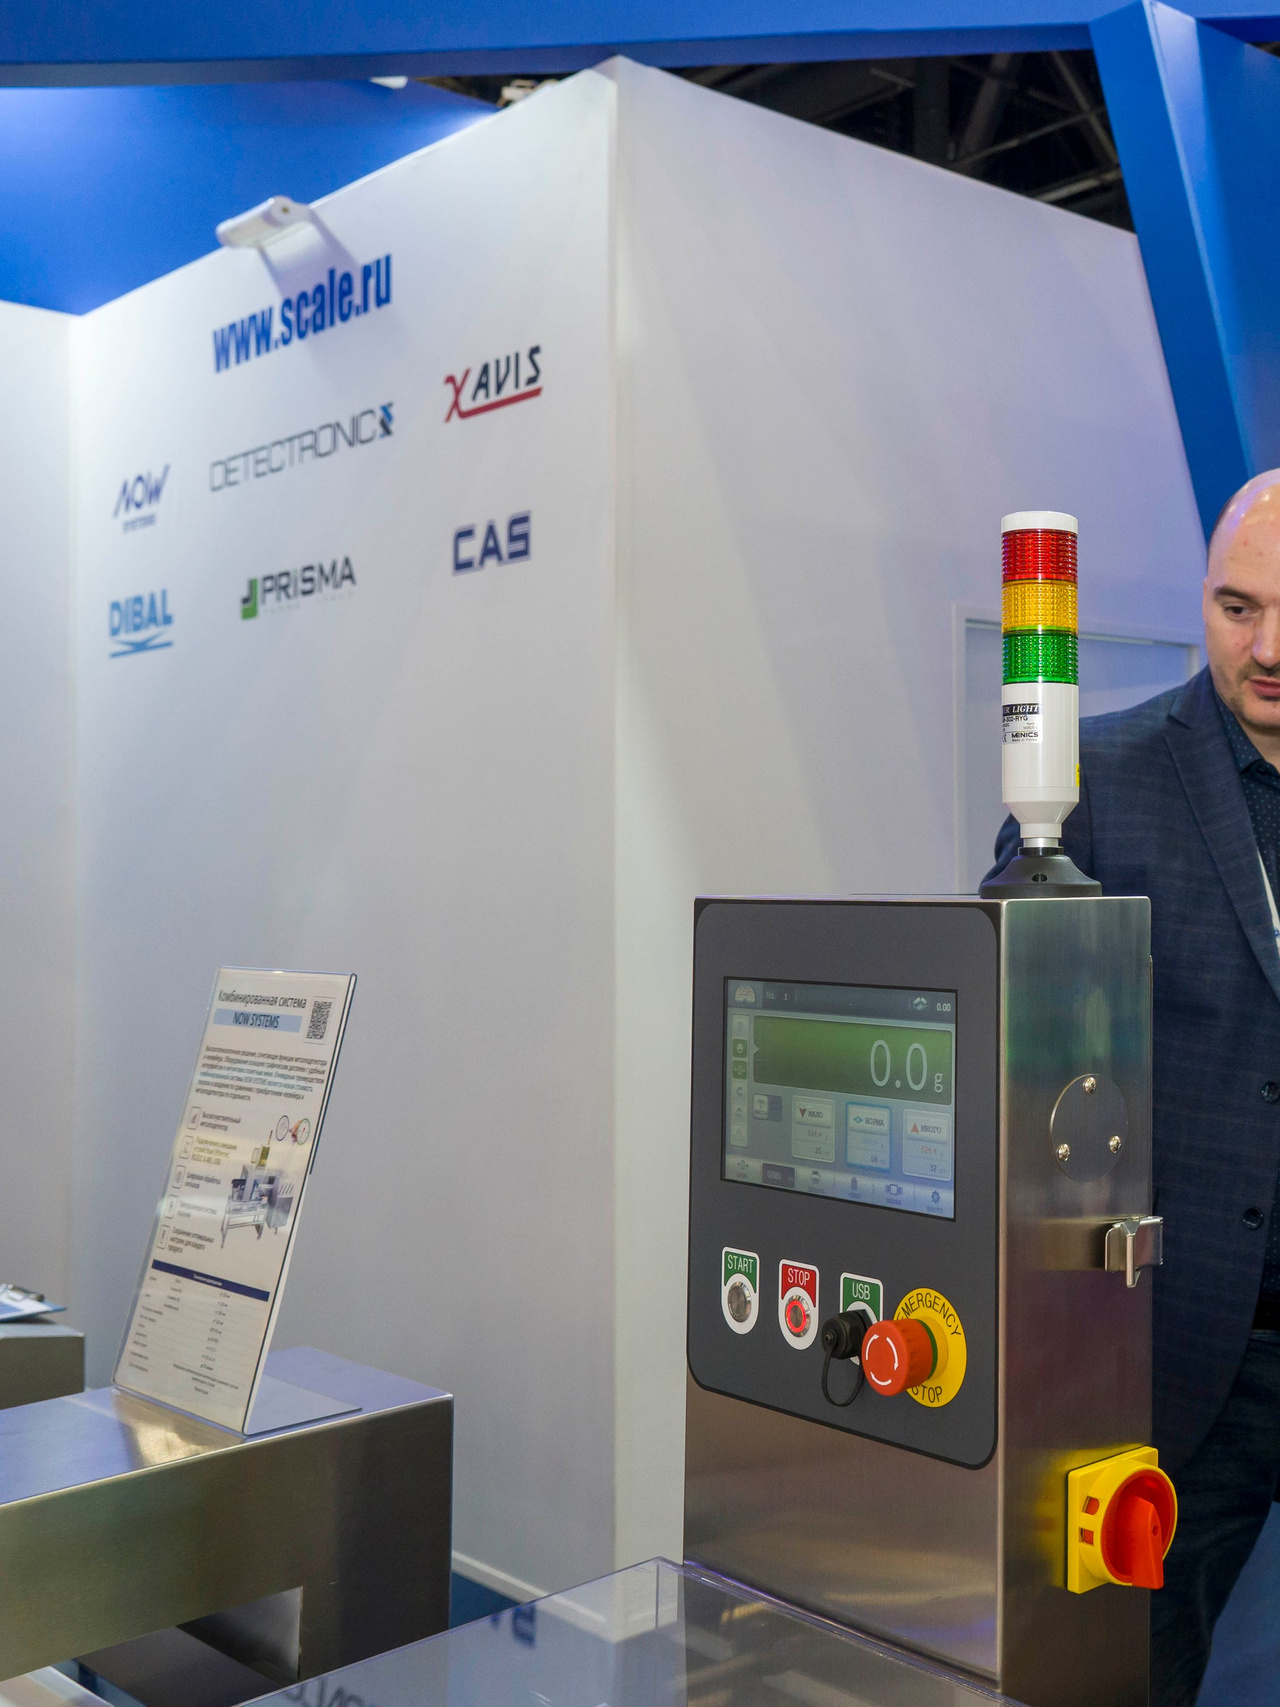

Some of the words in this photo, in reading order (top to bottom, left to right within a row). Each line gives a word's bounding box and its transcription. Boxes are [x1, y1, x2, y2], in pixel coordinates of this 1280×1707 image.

[212, 254, 393, 374] www.scale.ru
[443, 346, 541, 422] XAVIS
[453, 510, 532, 575] CAS
[108, 588, 174, 637] DIBAL
[1012, 705, 1038, 713] LIGHT
[218, 989, 278, 1007] Комбинированная
[936, 1002, 951, 1011] 0.00
[232, 1011, 250, 1025] NOW
[250, 1013, 280, 1029] SYSTEMS
[870, 1039, 928, 1091] 0.0
[934, 1072, 943, 1093] g
[864, 1117, 885, 1127] НОРМА
[920, 1124, 942, 1134] МНОГО
[929, 1164, 937, 1172] 32
[727, 1254, 754, 1273] START
[787, 1268, 810, 1286] STOP
[852, 1282, 871, 1300] USB
[912, 1384, 943, 1403] STOP
